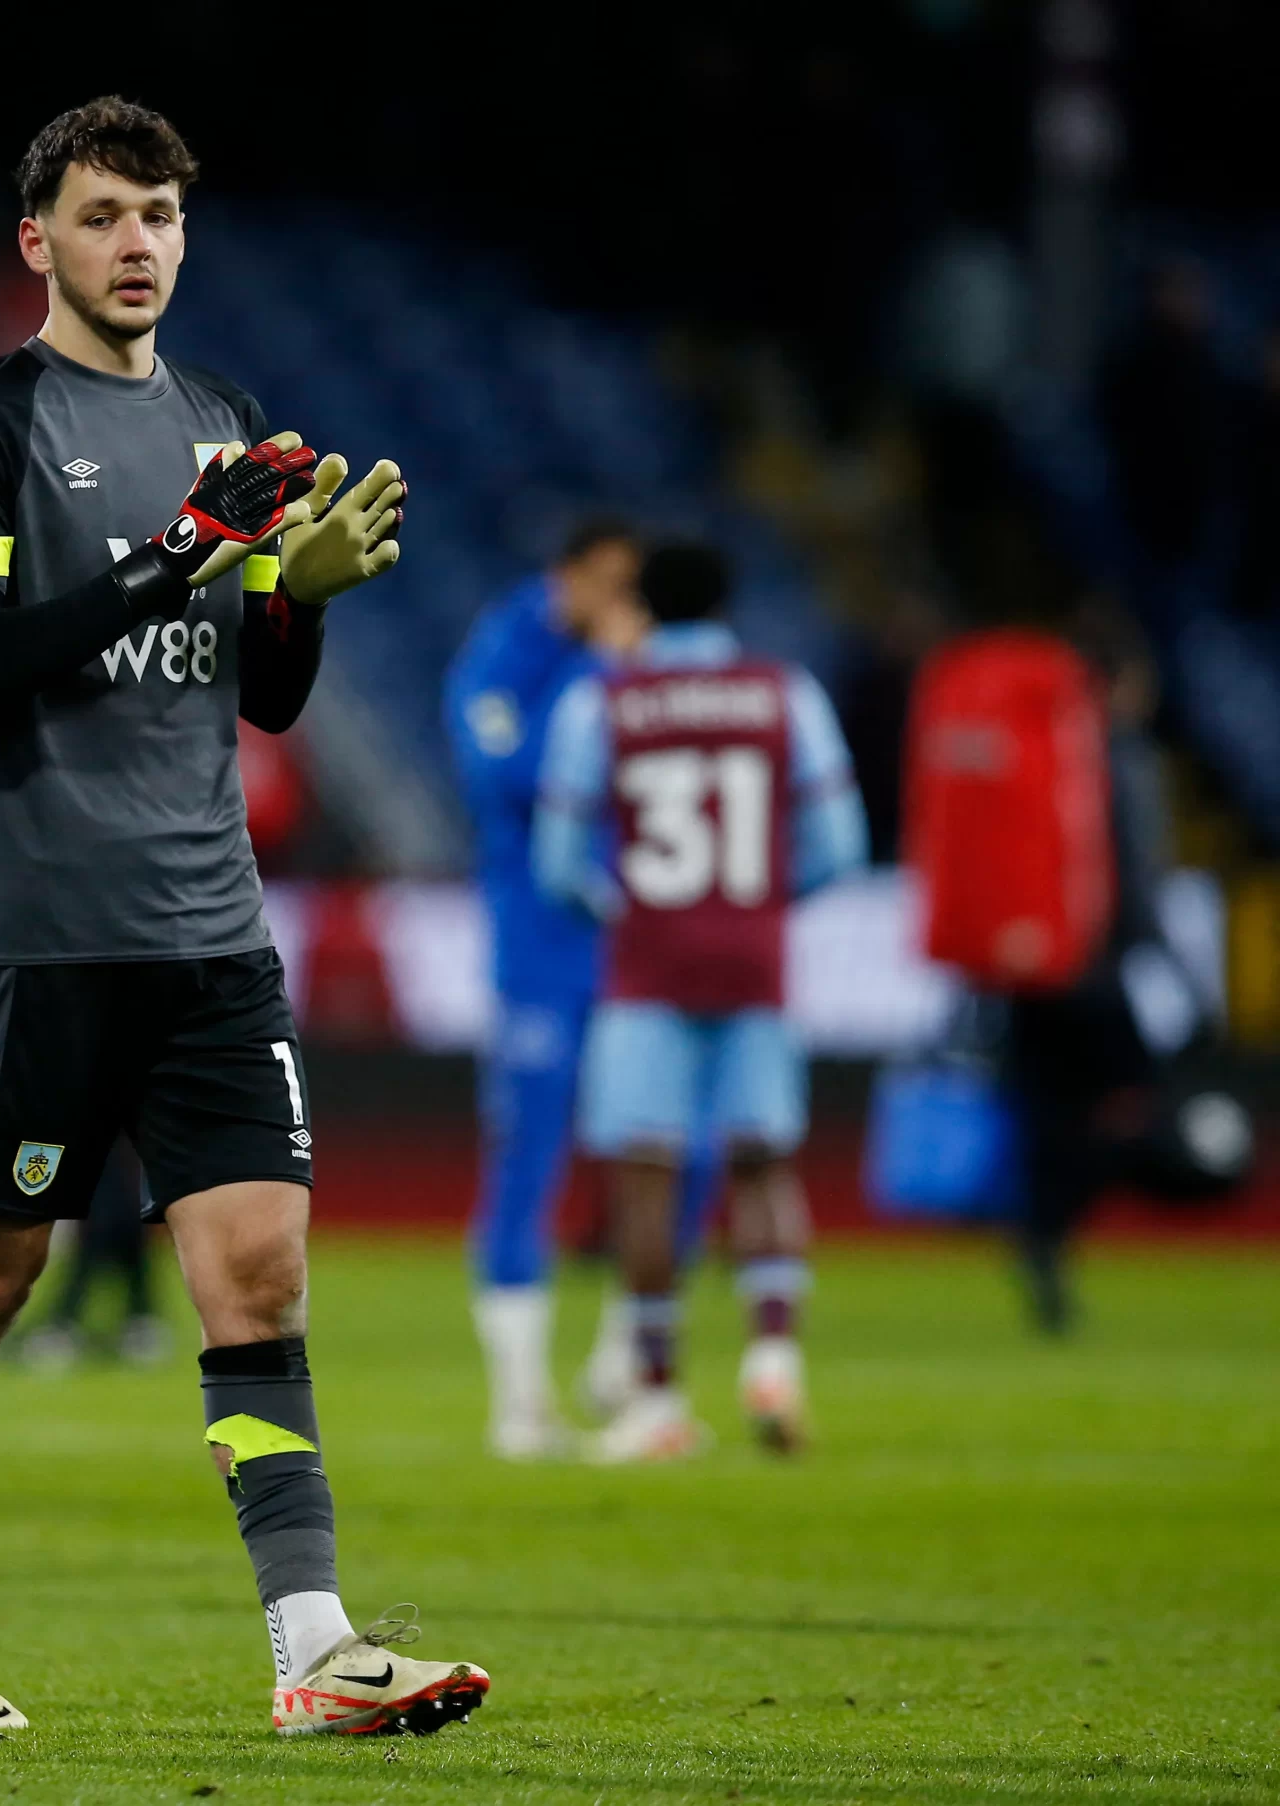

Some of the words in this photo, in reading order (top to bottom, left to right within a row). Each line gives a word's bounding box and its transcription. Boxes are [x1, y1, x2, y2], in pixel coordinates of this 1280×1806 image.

[68, 478, 98, 489] umbro
[101, 620, 218, 683] W88
[620, 744, 774, 909] 31
[270, 1041, 304, 1125] 1
